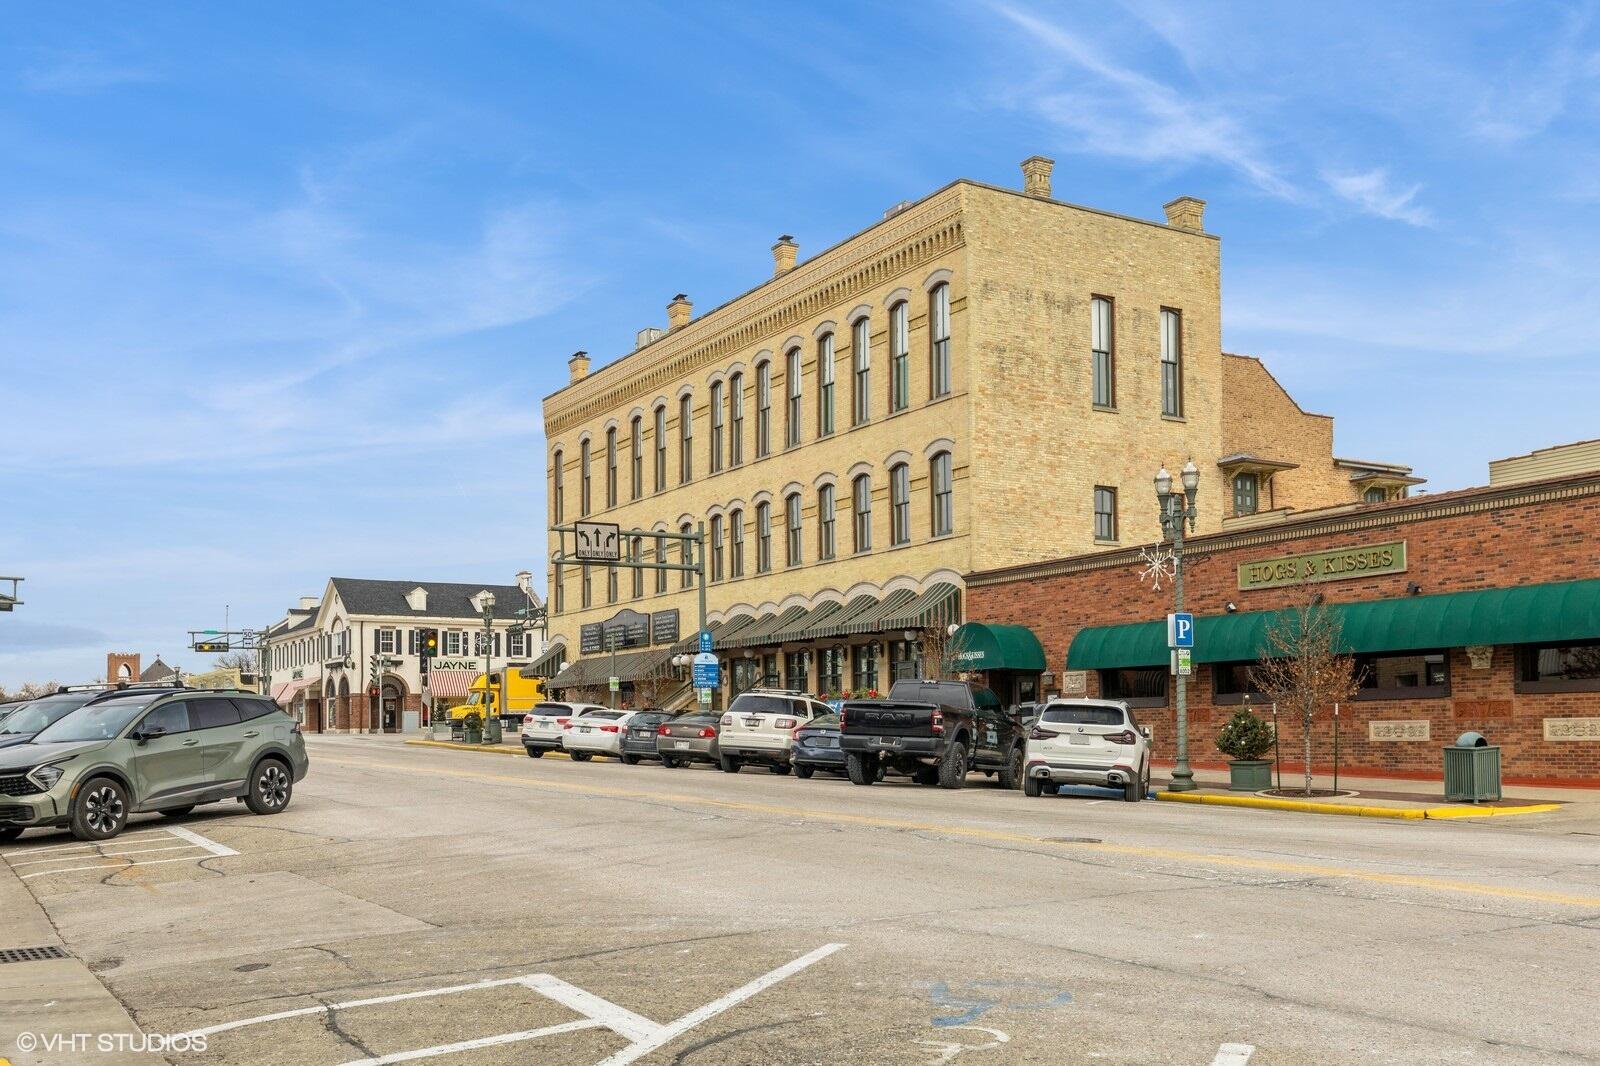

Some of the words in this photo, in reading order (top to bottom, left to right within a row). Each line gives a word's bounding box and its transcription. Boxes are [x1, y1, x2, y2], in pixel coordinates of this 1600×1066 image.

[592, 550, 605, 558] ONLY
[605, 550, 618, 558] ONLY
[1249, 562, 1298, 584] HOGS
[1302, 559, 1317, 579] &
[1323, 549, 1394, 576] KISSES
[1177, 619, 1191, 639] P
[433, 661, 477, 670] JAYNE
[864, 712, 912, 721] RAM
